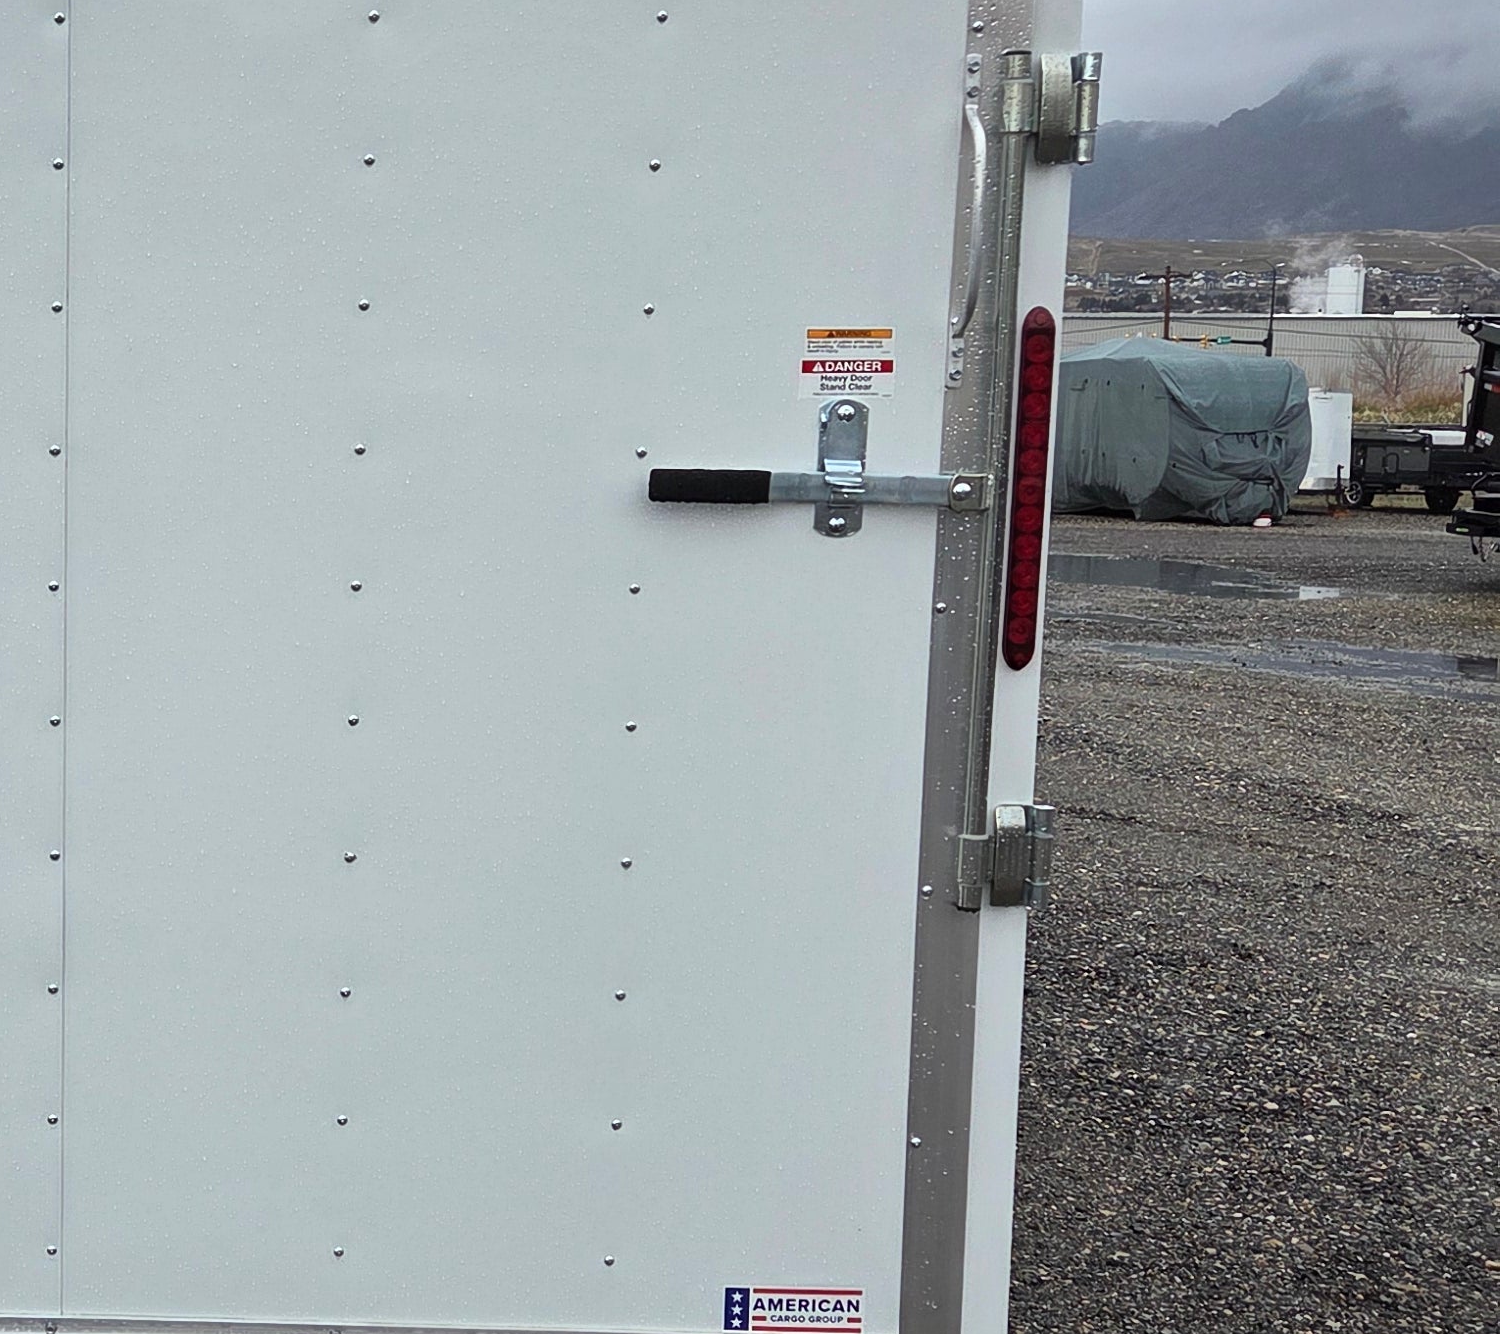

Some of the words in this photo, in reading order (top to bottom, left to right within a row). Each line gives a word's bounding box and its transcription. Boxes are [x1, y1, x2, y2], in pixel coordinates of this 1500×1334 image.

[825, 361, 882, 372] DANGER
[820, 374, 848, 384] Heavy
[850, 374, 873, 382] Door
[820, 383, 846, 391] Stand
[848, 383, 873, 391] Clear
[752, 1298, 860, 1313] AMERICAN
[770, 1314, 805, 1323] CARGO
[808, 1315, 844, 1324] GROUP
